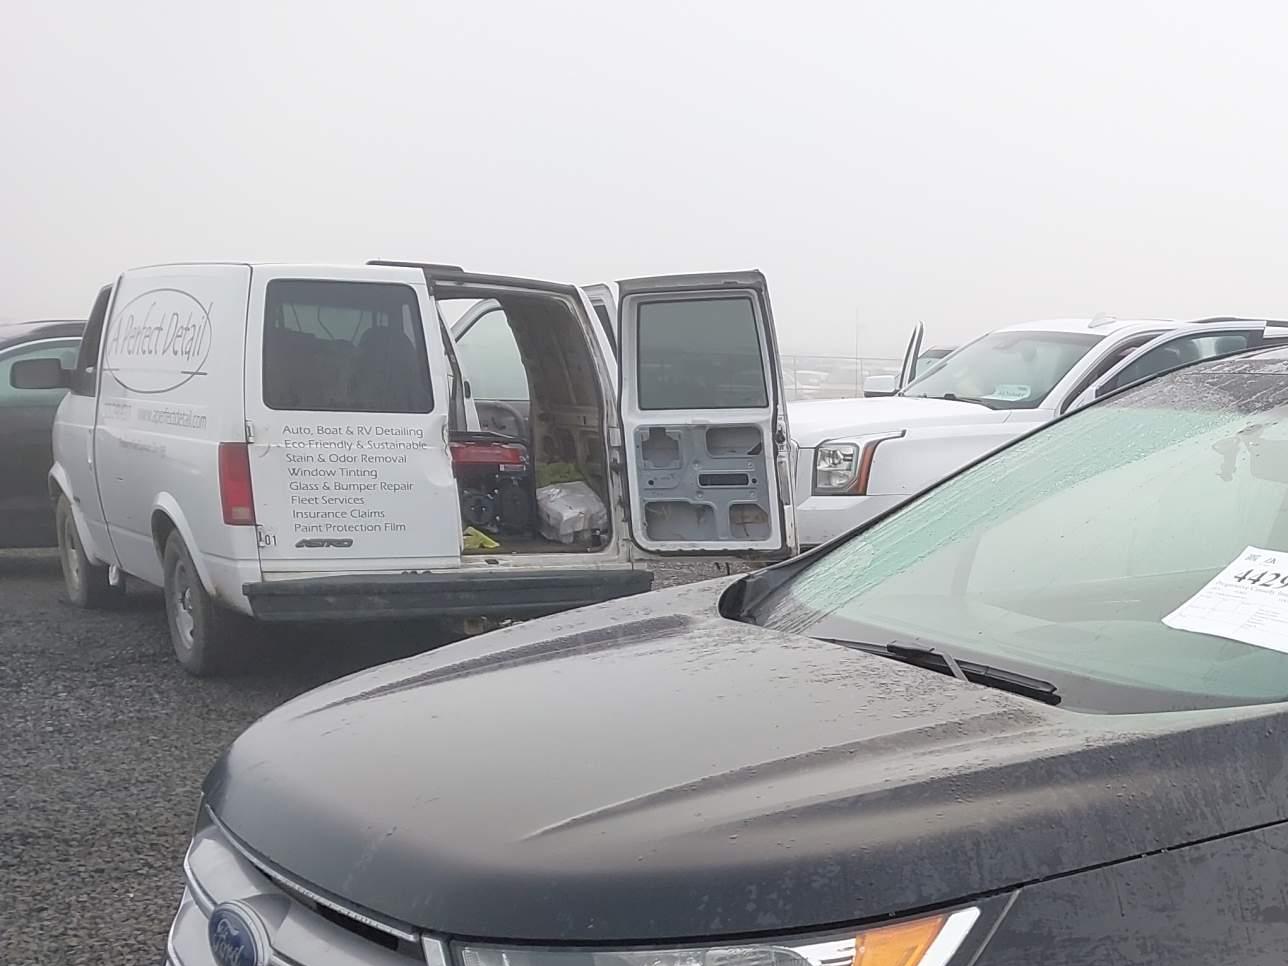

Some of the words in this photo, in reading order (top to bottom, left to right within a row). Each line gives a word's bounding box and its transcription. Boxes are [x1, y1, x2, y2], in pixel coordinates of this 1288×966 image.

[121, 302, 164, 357] Perfect
[162, 302, 214, 361] Detail
[282, 425, 314, 436] Auto,
[316, 426, 343, 435] Boat
[345, 426, 354, 435] &
[357, 426, 372, 435] RV
[375, 426, 424, 438] Detailing
[284, 440, 353, 450] Eco-Friendly
[356, 441, 366, 450] &
[367, 440, 427, 450] Sustainable
[286, 453, 314, 463] Stain
[317, 454, 326, 463] &
[328, 453, 358, 463] Odor
[361, 454, 407, 463] Removal
[288, 467, 337, 477] Window
[339, 468, 378, 479] Tinting
[289, 482, 319, 491] Glass
[322, 482, 330, 491] &
[334, 482, 377, 492] Bumper
[380, 482, 414, 492] Repair
[291, 496, 319, 505] Fleet
[321, 496, 365, 505] Services
[292, 510, 347, 519] Insurance
[350, 509, 385, 518] Claims
[294, 523, 322, 533] Paint
[325, 523, 381, 532] Protection
[384, 522, 406, 531] Film
